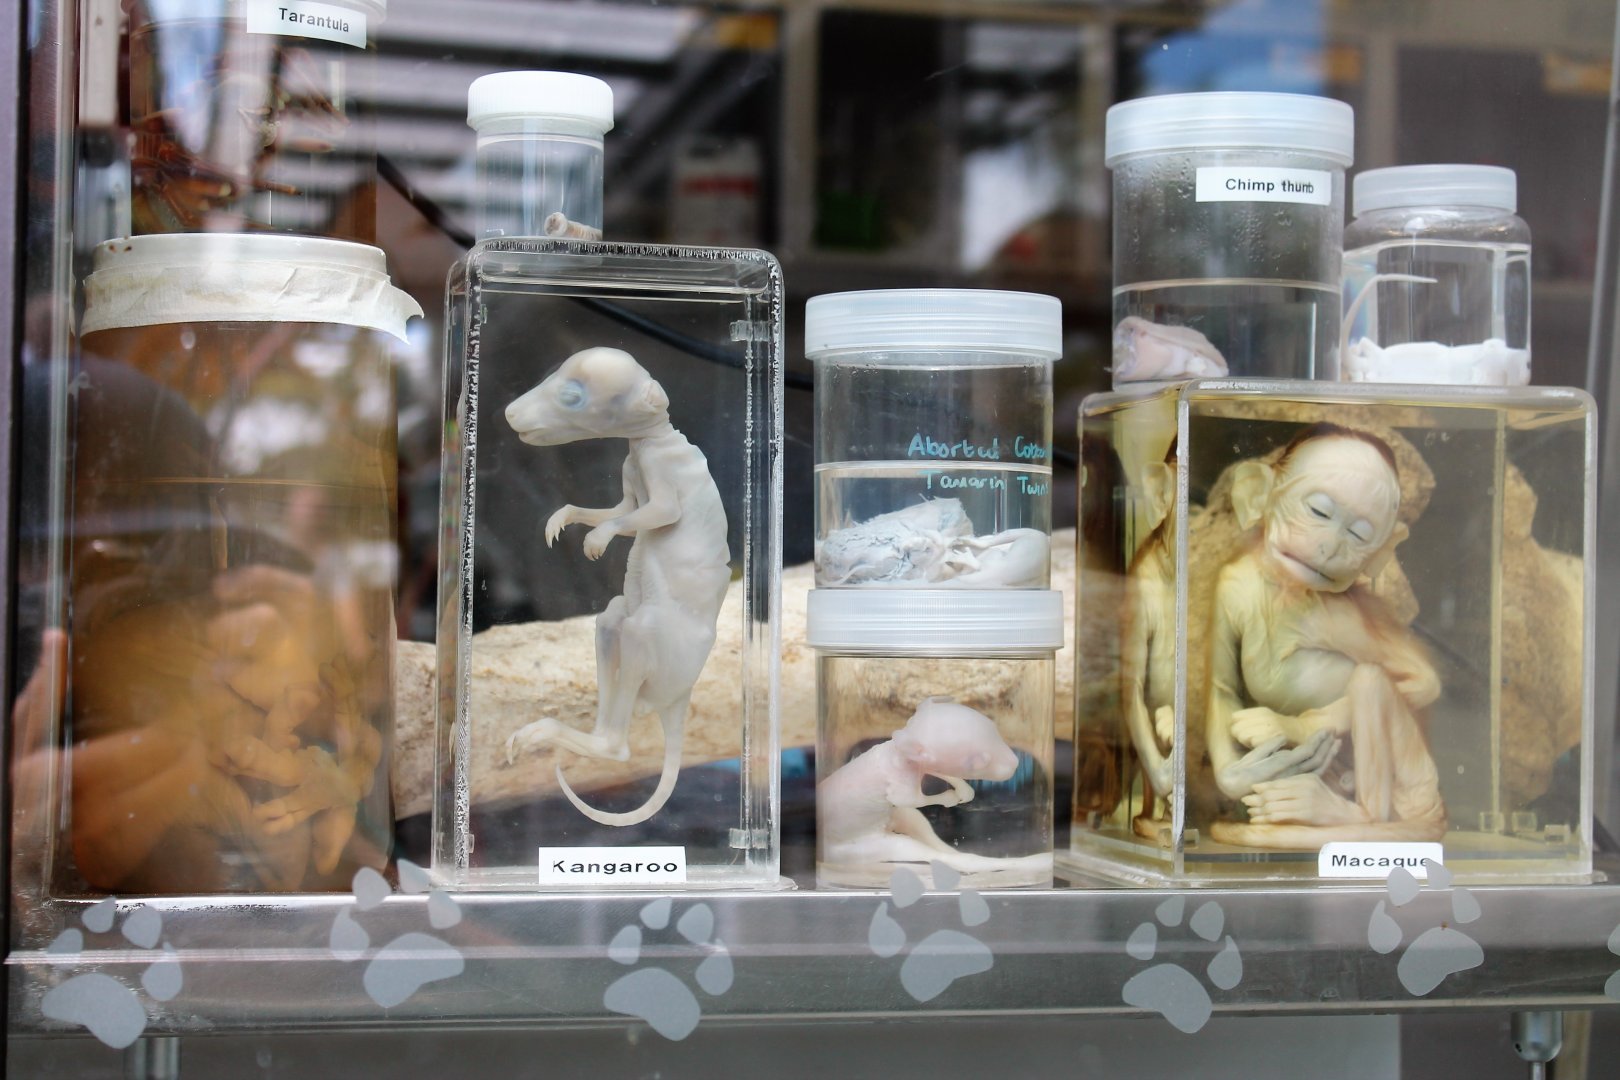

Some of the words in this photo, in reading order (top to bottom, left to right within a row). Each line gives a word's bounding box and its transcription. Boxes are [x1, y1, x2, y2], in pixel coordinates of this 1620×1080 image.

[279, 7, 349, 32] Tarantula
[1225, 178, 1275, 193] Chimp
[1280, 179, 1314, 194] thumb
[907, 432, 1000, 459] Aborted
[918, 470, 1005, 489] Tamarin
[553, 860, 678, 875] Kangaroo
